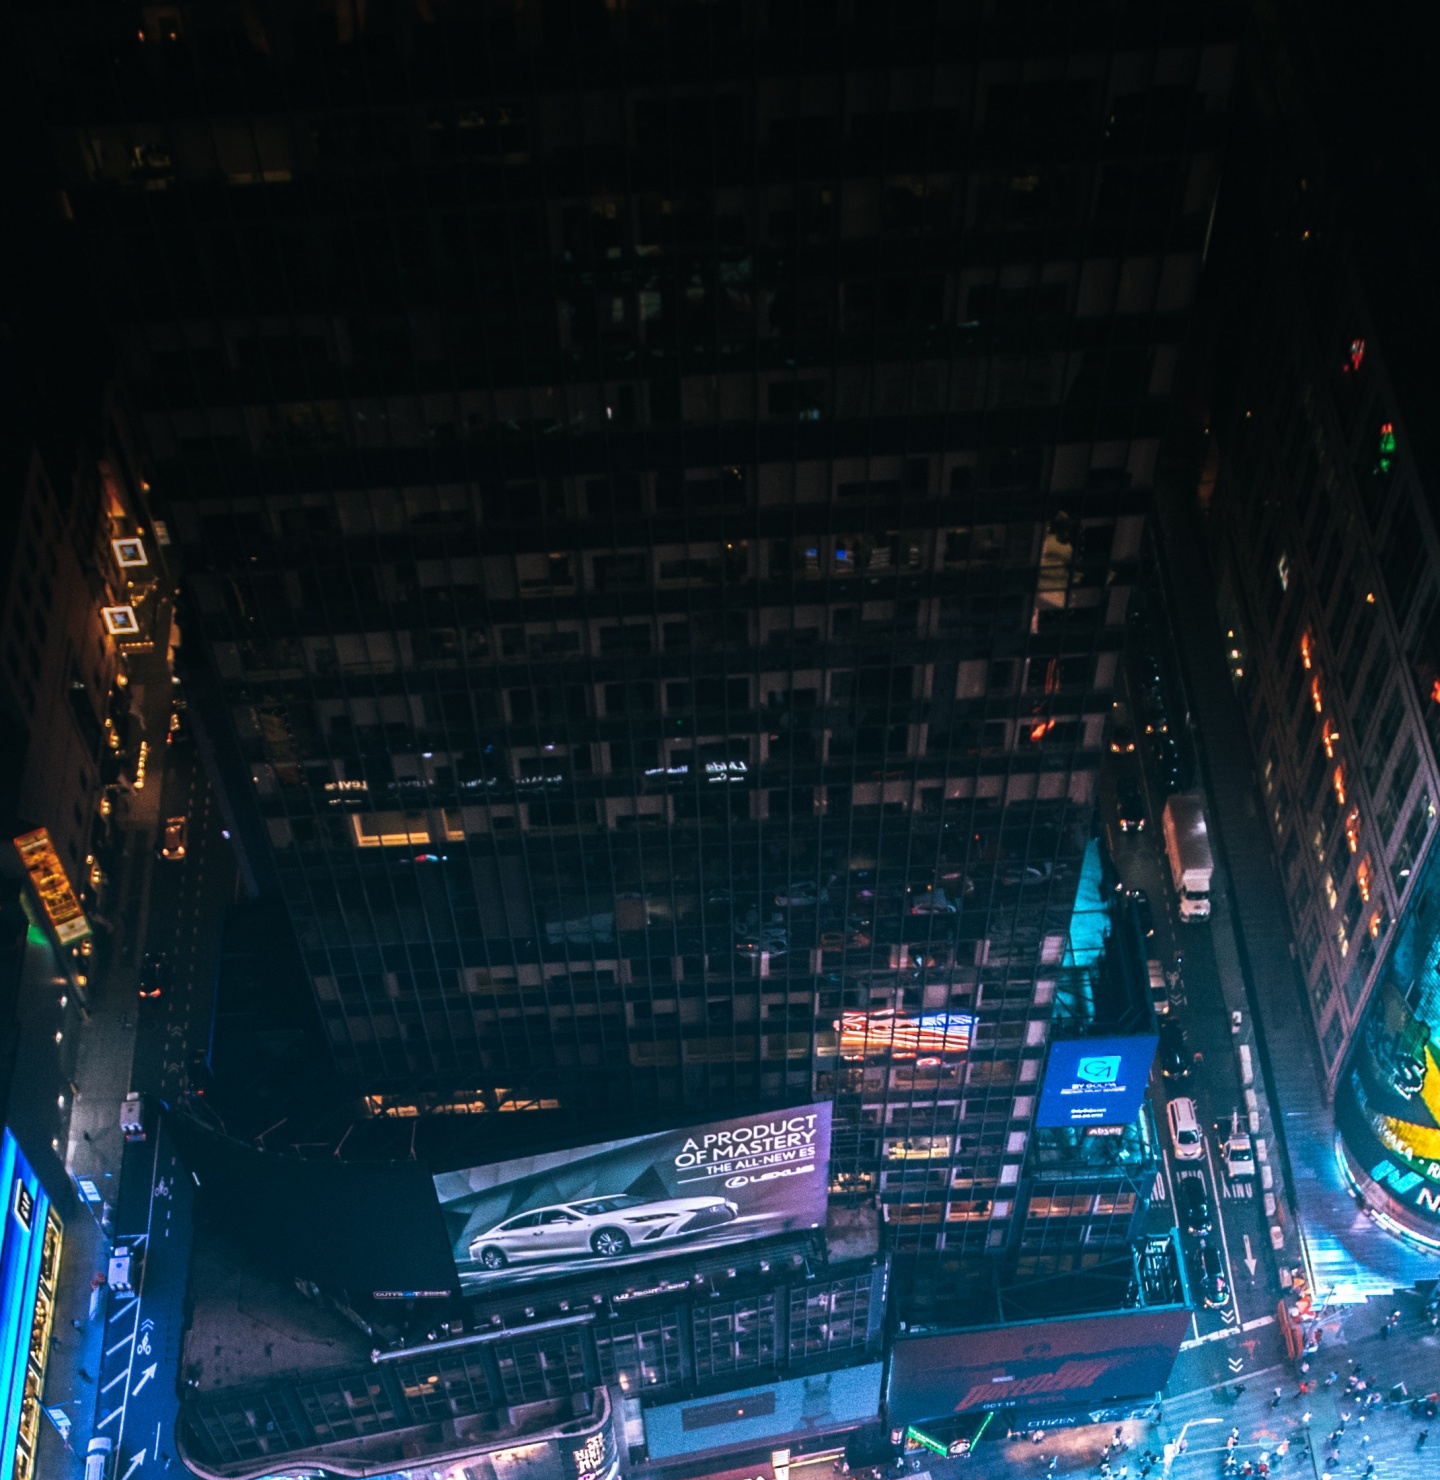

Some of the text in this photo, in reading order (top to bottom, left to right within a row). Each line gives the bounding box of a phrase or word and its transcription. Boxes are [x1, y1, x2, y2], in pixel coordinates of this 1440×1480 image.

[682, 1114, 817, 1152] A PRODUCT
[675, 1129, 816, 1167] OF MASTERY
[706, 1146, 816, 1175] THE ALL-NEW ES
[751, 1164, 815, 1182] LEXUS
[1028, 1417, 1076, 1428] CITIZEN
